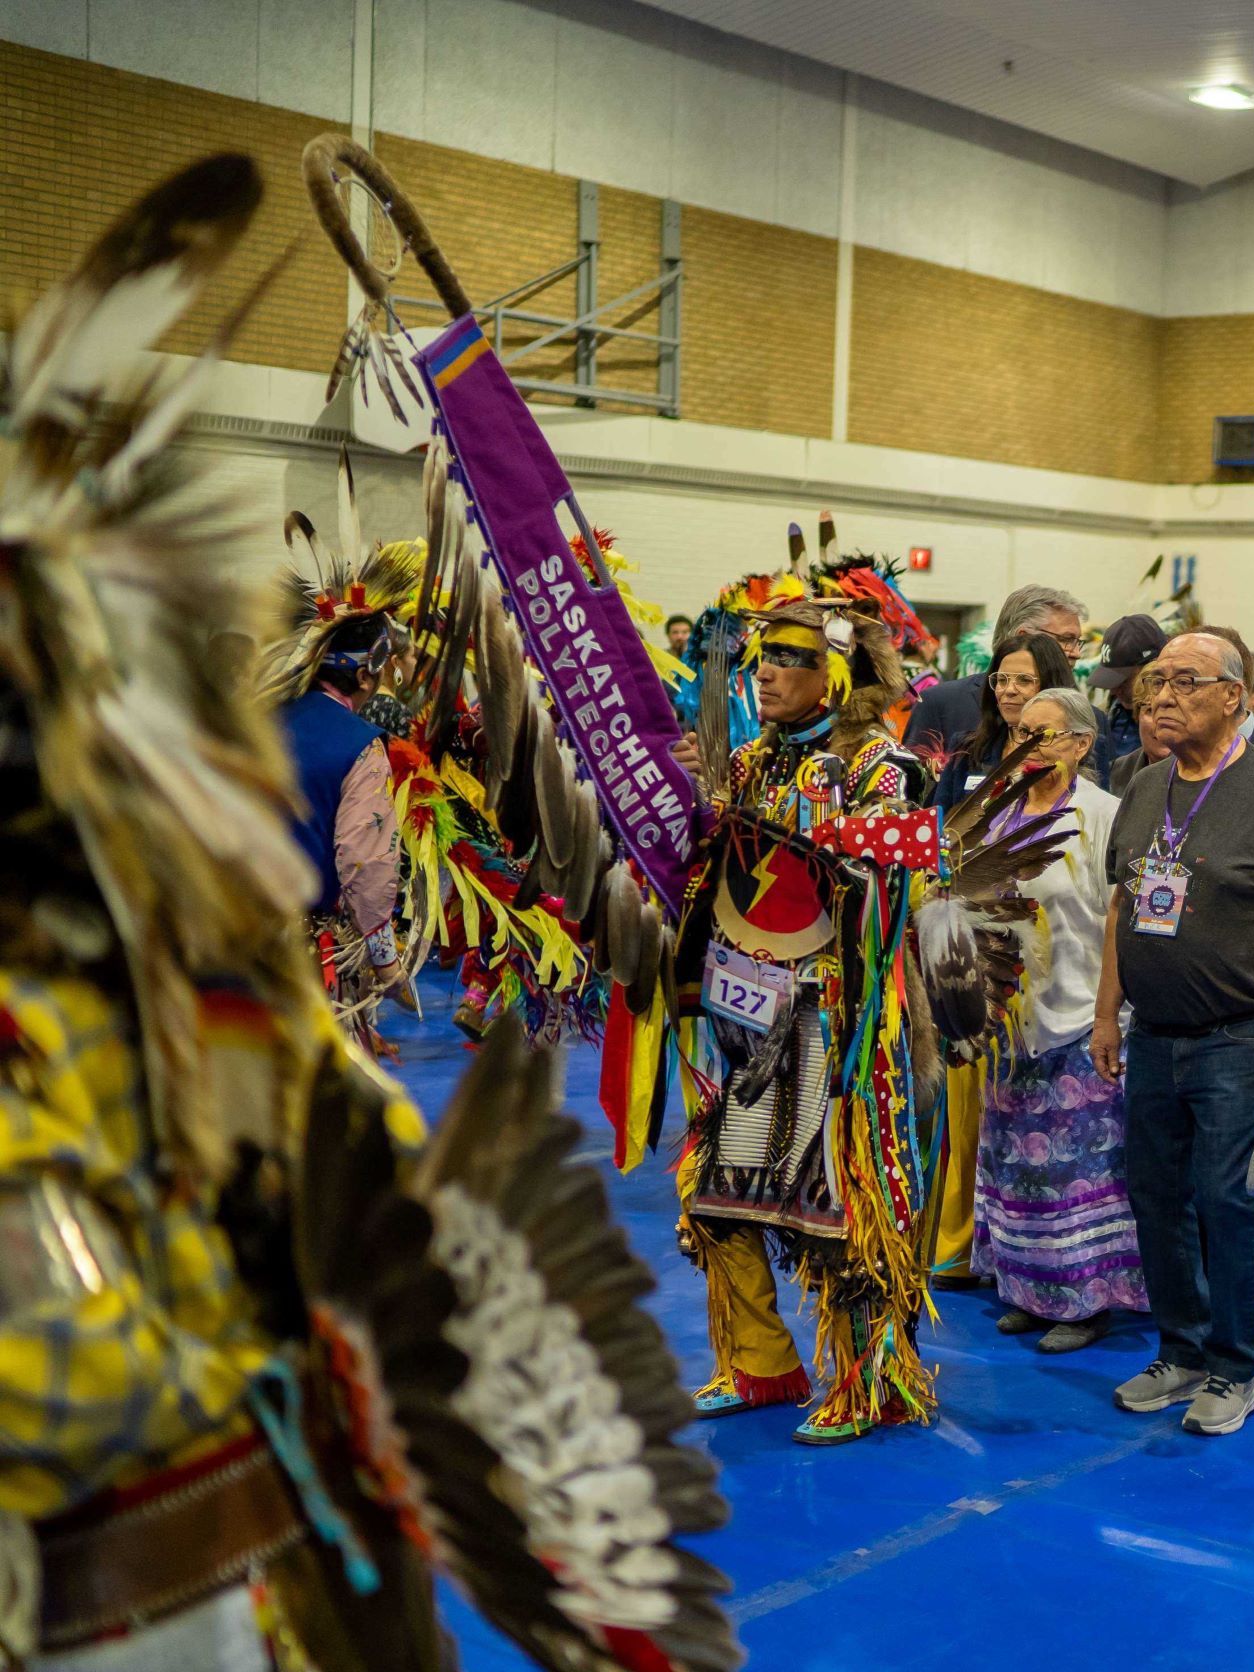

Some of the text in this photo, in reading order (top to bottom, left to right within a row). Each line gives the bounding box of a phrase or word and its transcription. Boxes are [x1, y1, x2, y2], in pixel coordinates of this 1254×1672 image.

[516, 567, 661, 849] POLYTECHNIC
[540, 555, 692, 863] SASKATCHEWAN
[719, 978, 768, 1015] 127
